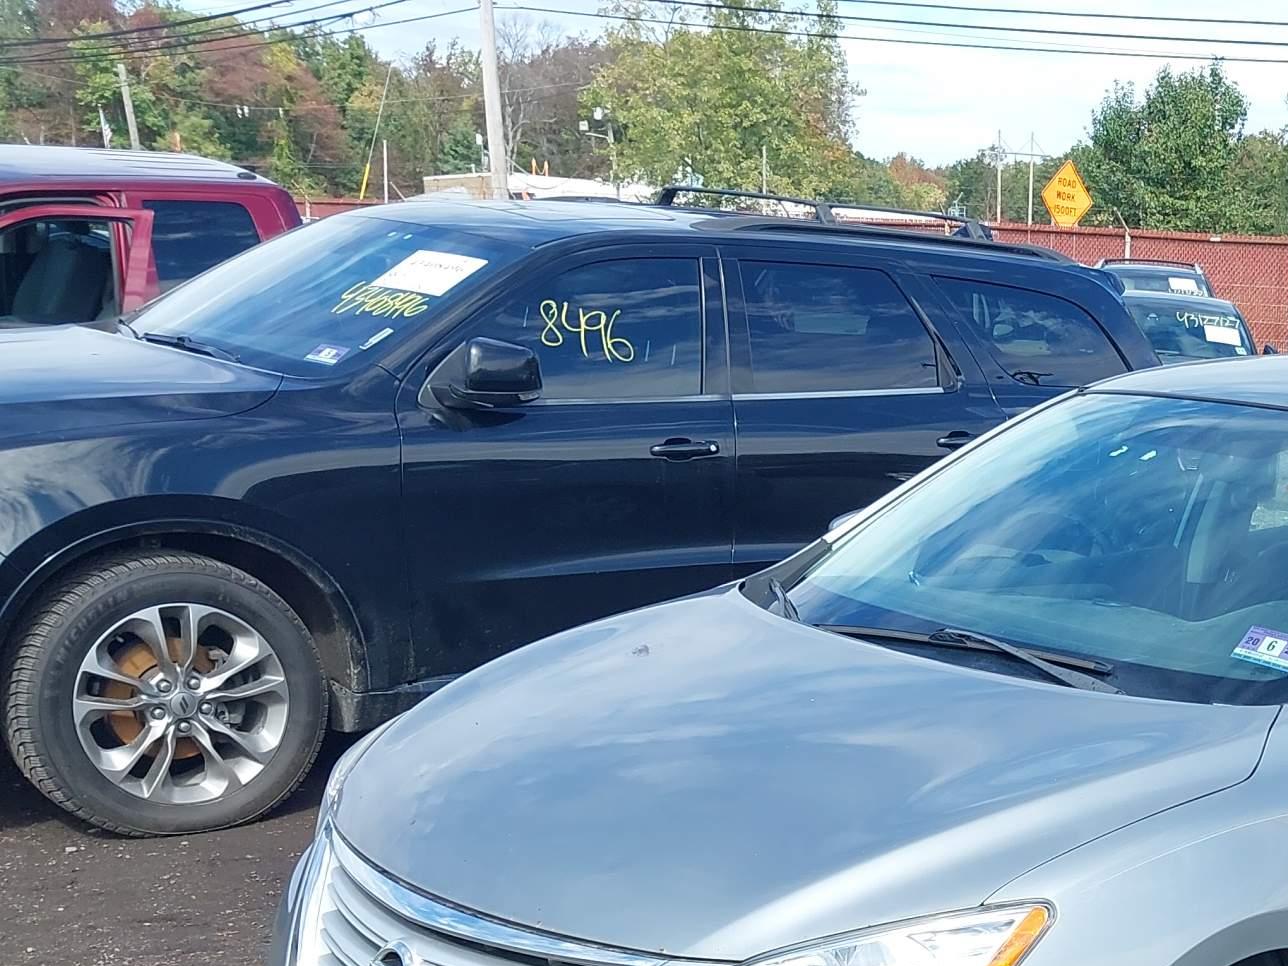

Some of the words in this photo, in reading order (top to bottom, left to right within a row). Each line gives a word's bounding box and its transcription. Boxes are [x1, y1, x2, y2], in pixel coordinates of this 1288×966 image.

[1057, 178, 1077, 189] ROAD
[1056, 190, 1076, 201] WORK
[1053, 204, 1077, 217] 1500FT
[1176, 311, 1241, 329] 43127127
[540, 299, 635, 363] 8496
[1245, 636, 1261, 646] 20
[1266, 640, 1278, 652] 6
